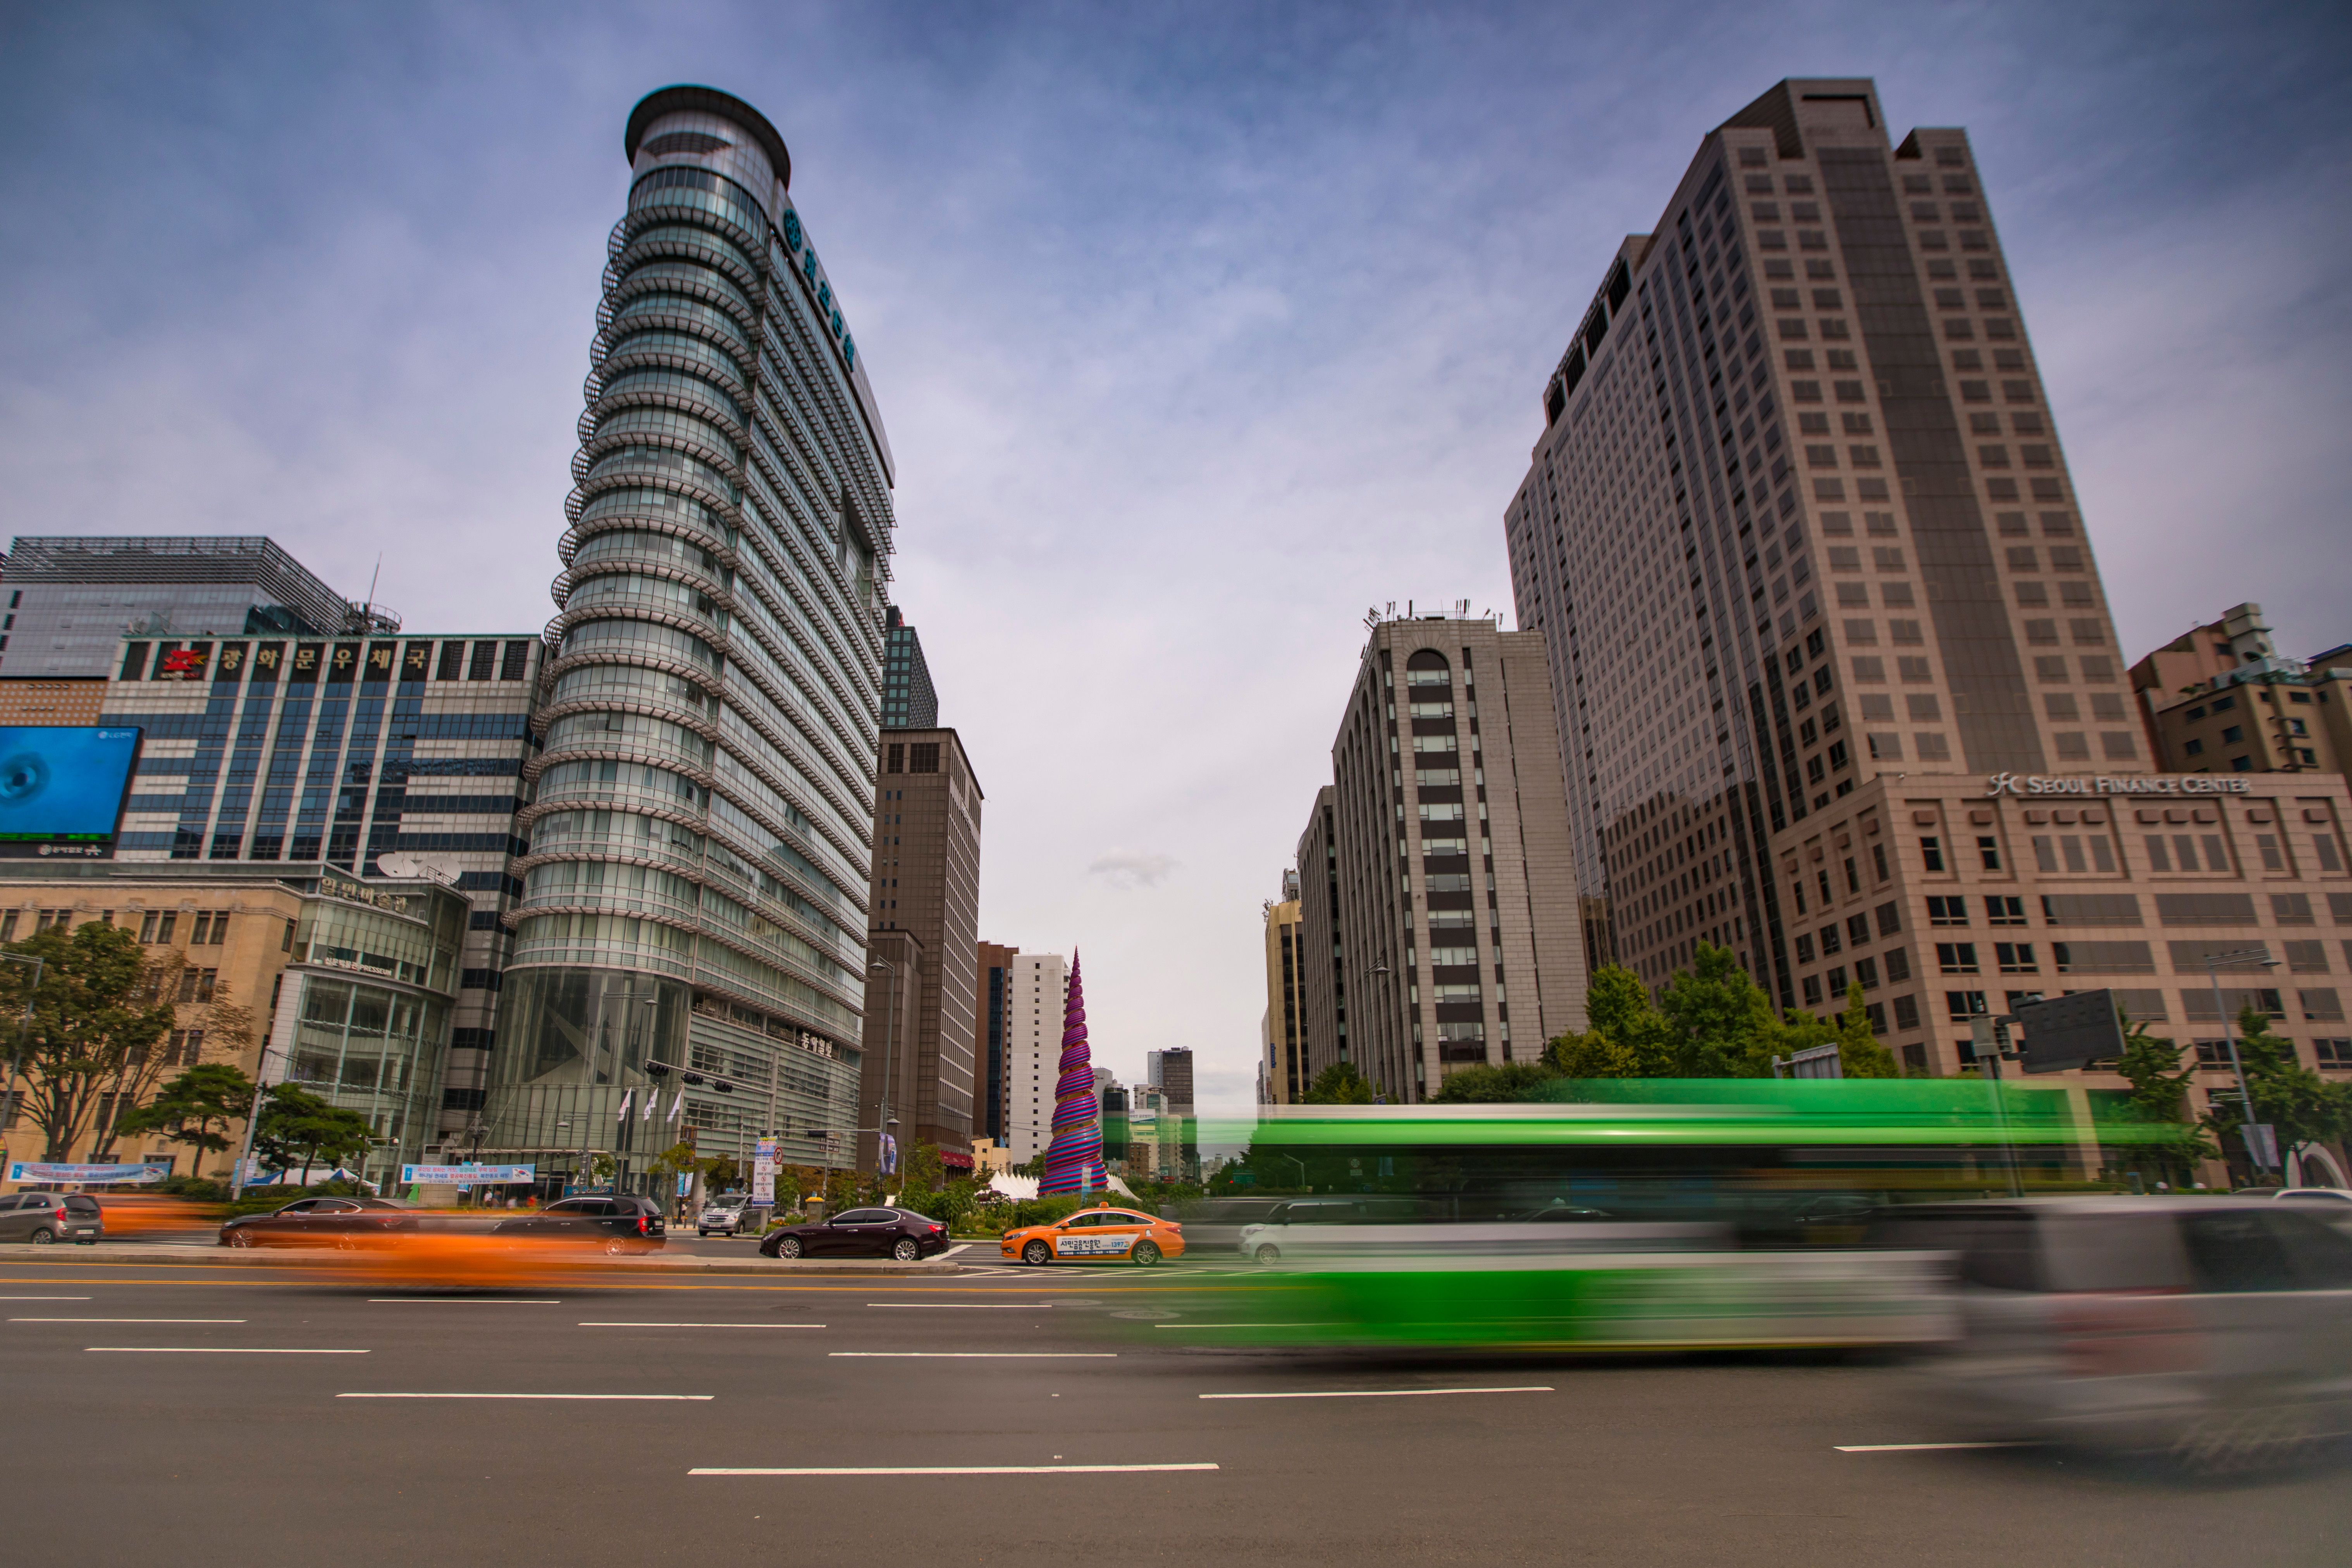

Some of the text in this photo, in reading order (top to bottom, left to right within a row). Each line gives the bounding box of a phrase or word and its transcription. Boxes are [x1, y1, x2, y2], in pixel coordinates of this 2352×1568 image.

[221, 649, 426, 670] 광화문우체국
[2027, 776, 2092, 794] SEOUL
[2095, 776, 2180, 793] FINANCE
[2180, 776, 2252, 793] CENTER
[322, 878, 407, 914] 일민미술관
[801, 1031, 833, 1058] 동아일보
[1060, 1239, 1100, 1250] 서민금융진흥원
